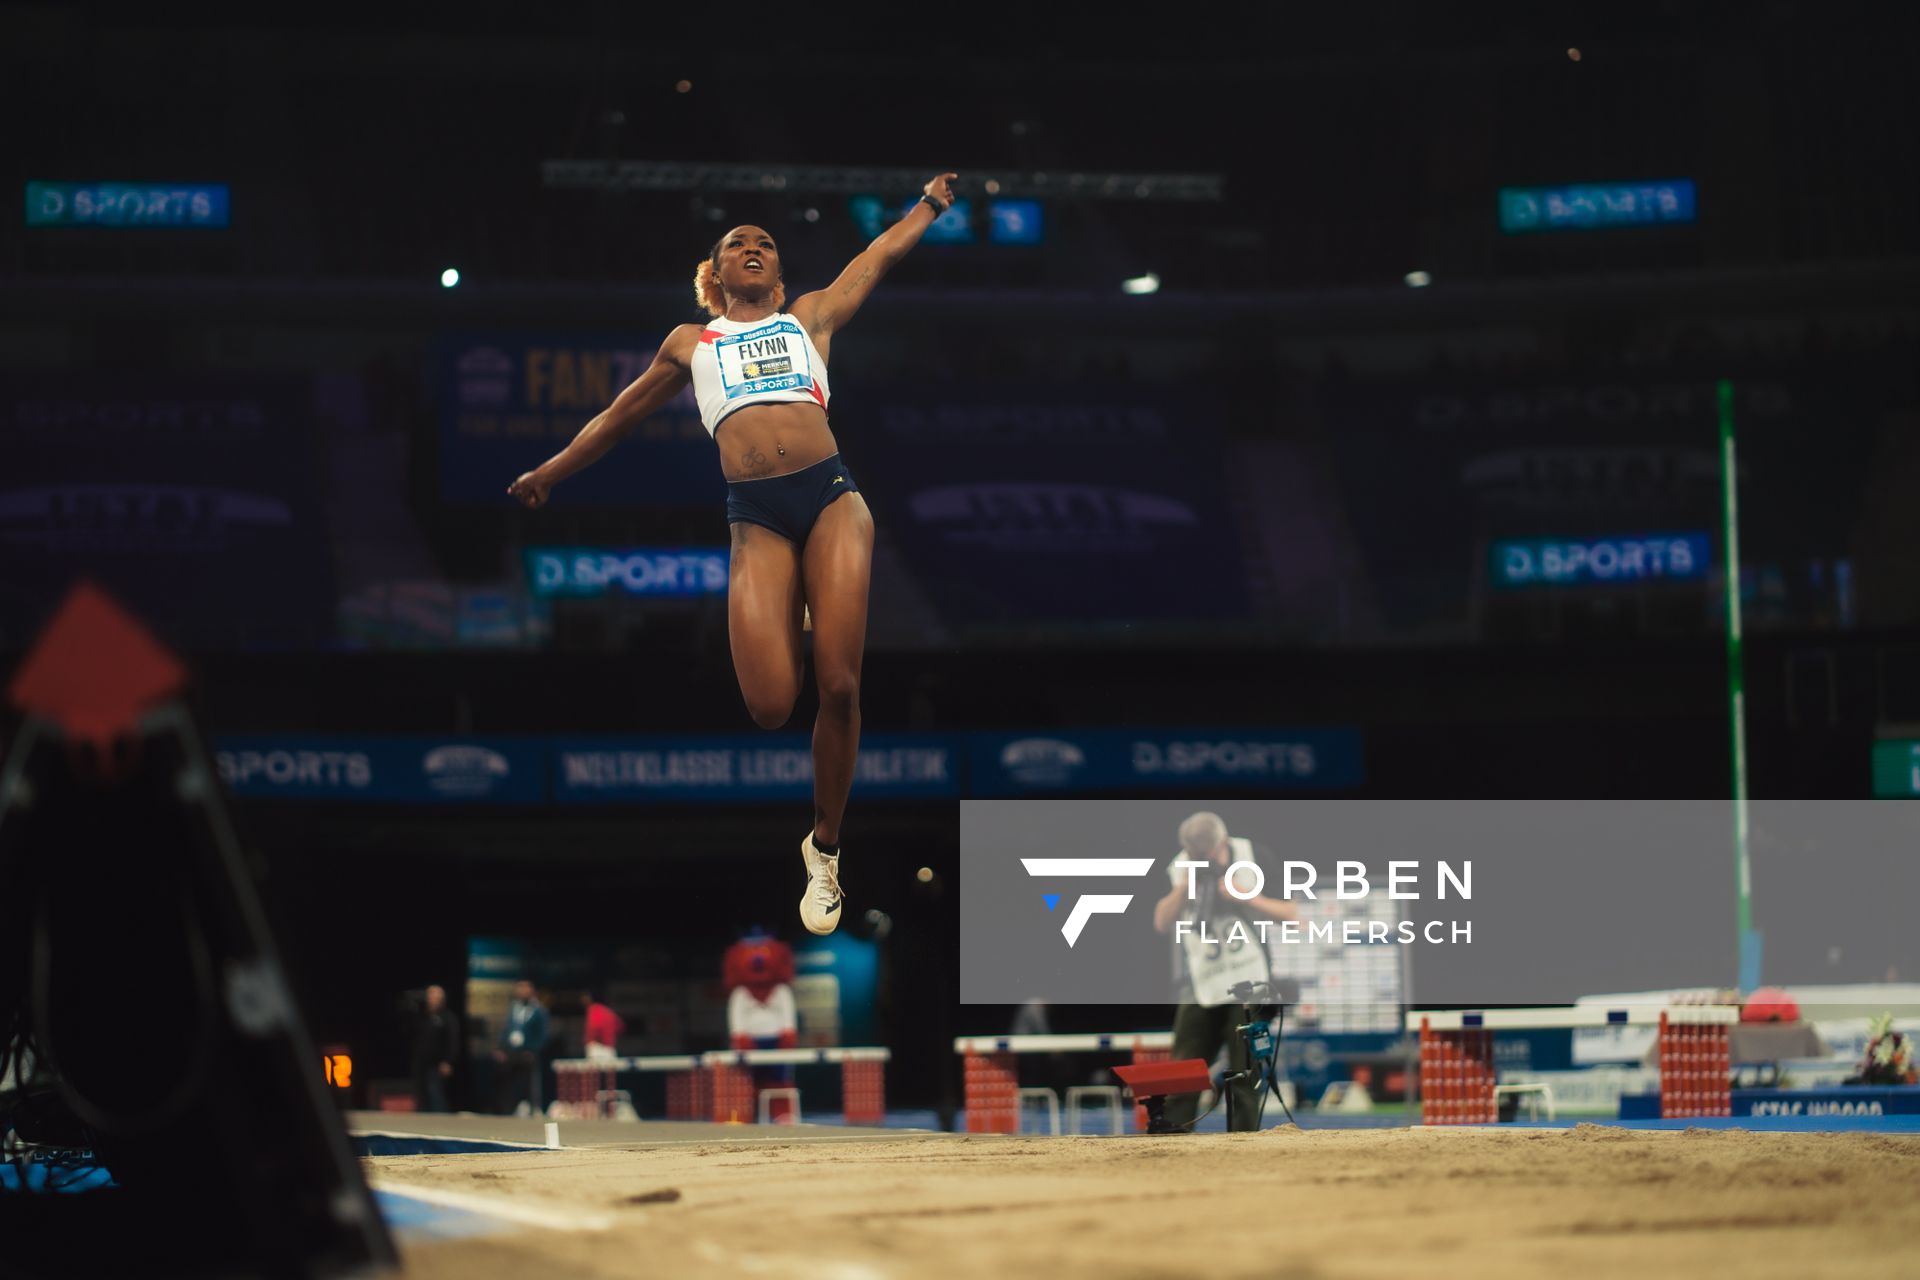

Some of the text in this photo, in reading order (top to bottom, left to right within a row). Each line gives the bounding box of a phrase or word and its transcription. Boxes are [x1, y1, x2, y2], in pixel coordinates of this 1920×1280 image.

[738, 336, 788, 360] FLYNN
[525, 348, 697, 408] FANZ
[745, 377, 796, 393] D.SPORTS
